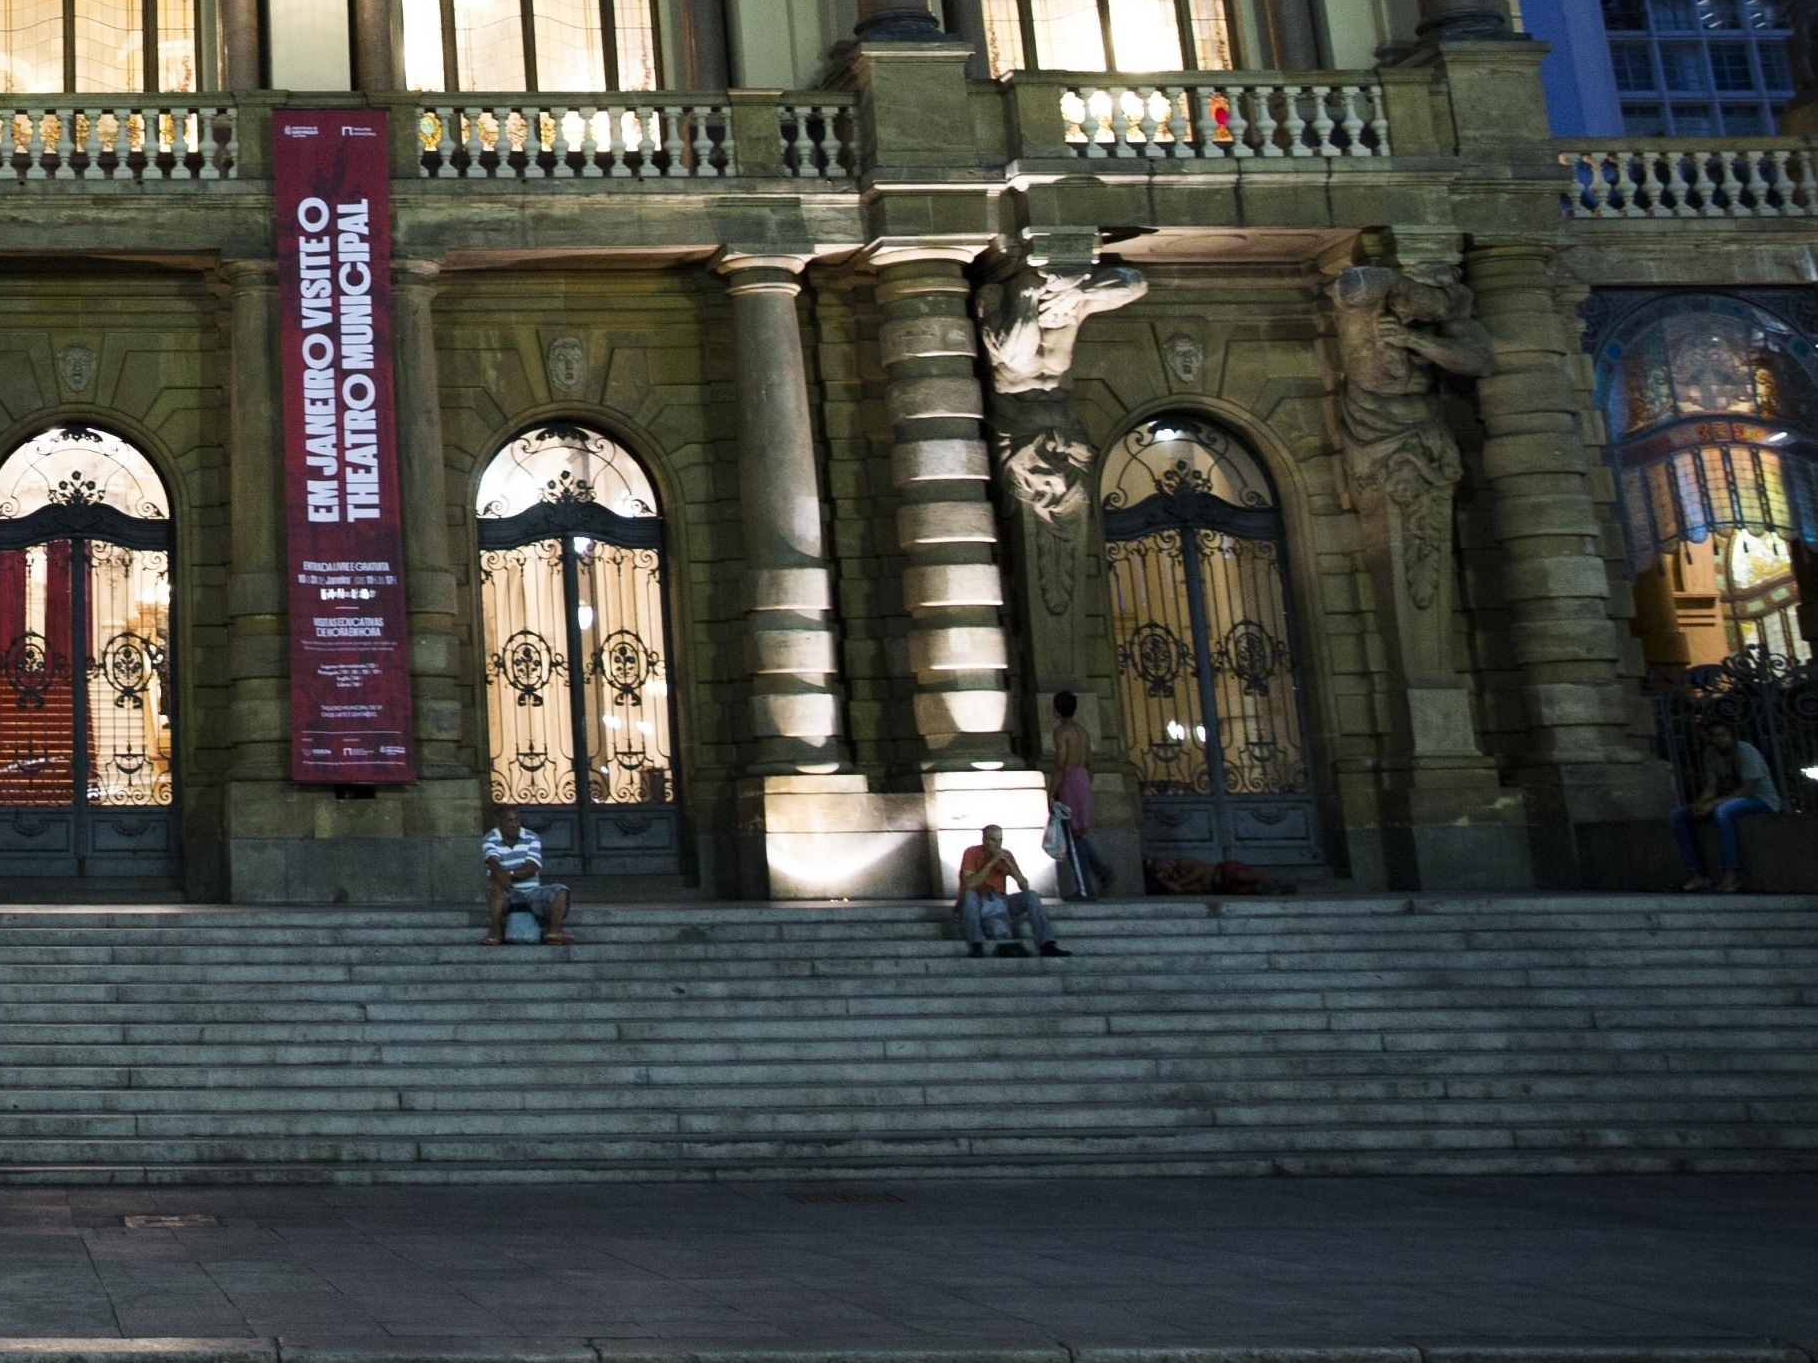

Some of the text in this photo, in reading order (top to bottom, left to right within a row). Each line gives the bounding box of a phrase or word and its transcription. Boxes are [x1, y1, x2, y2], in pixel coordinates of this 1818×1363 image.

[297, 196, 340, 523] EM JANEIRO VISITE O
[337, 198, 380, 523] THEATRO MUNICIPAL
